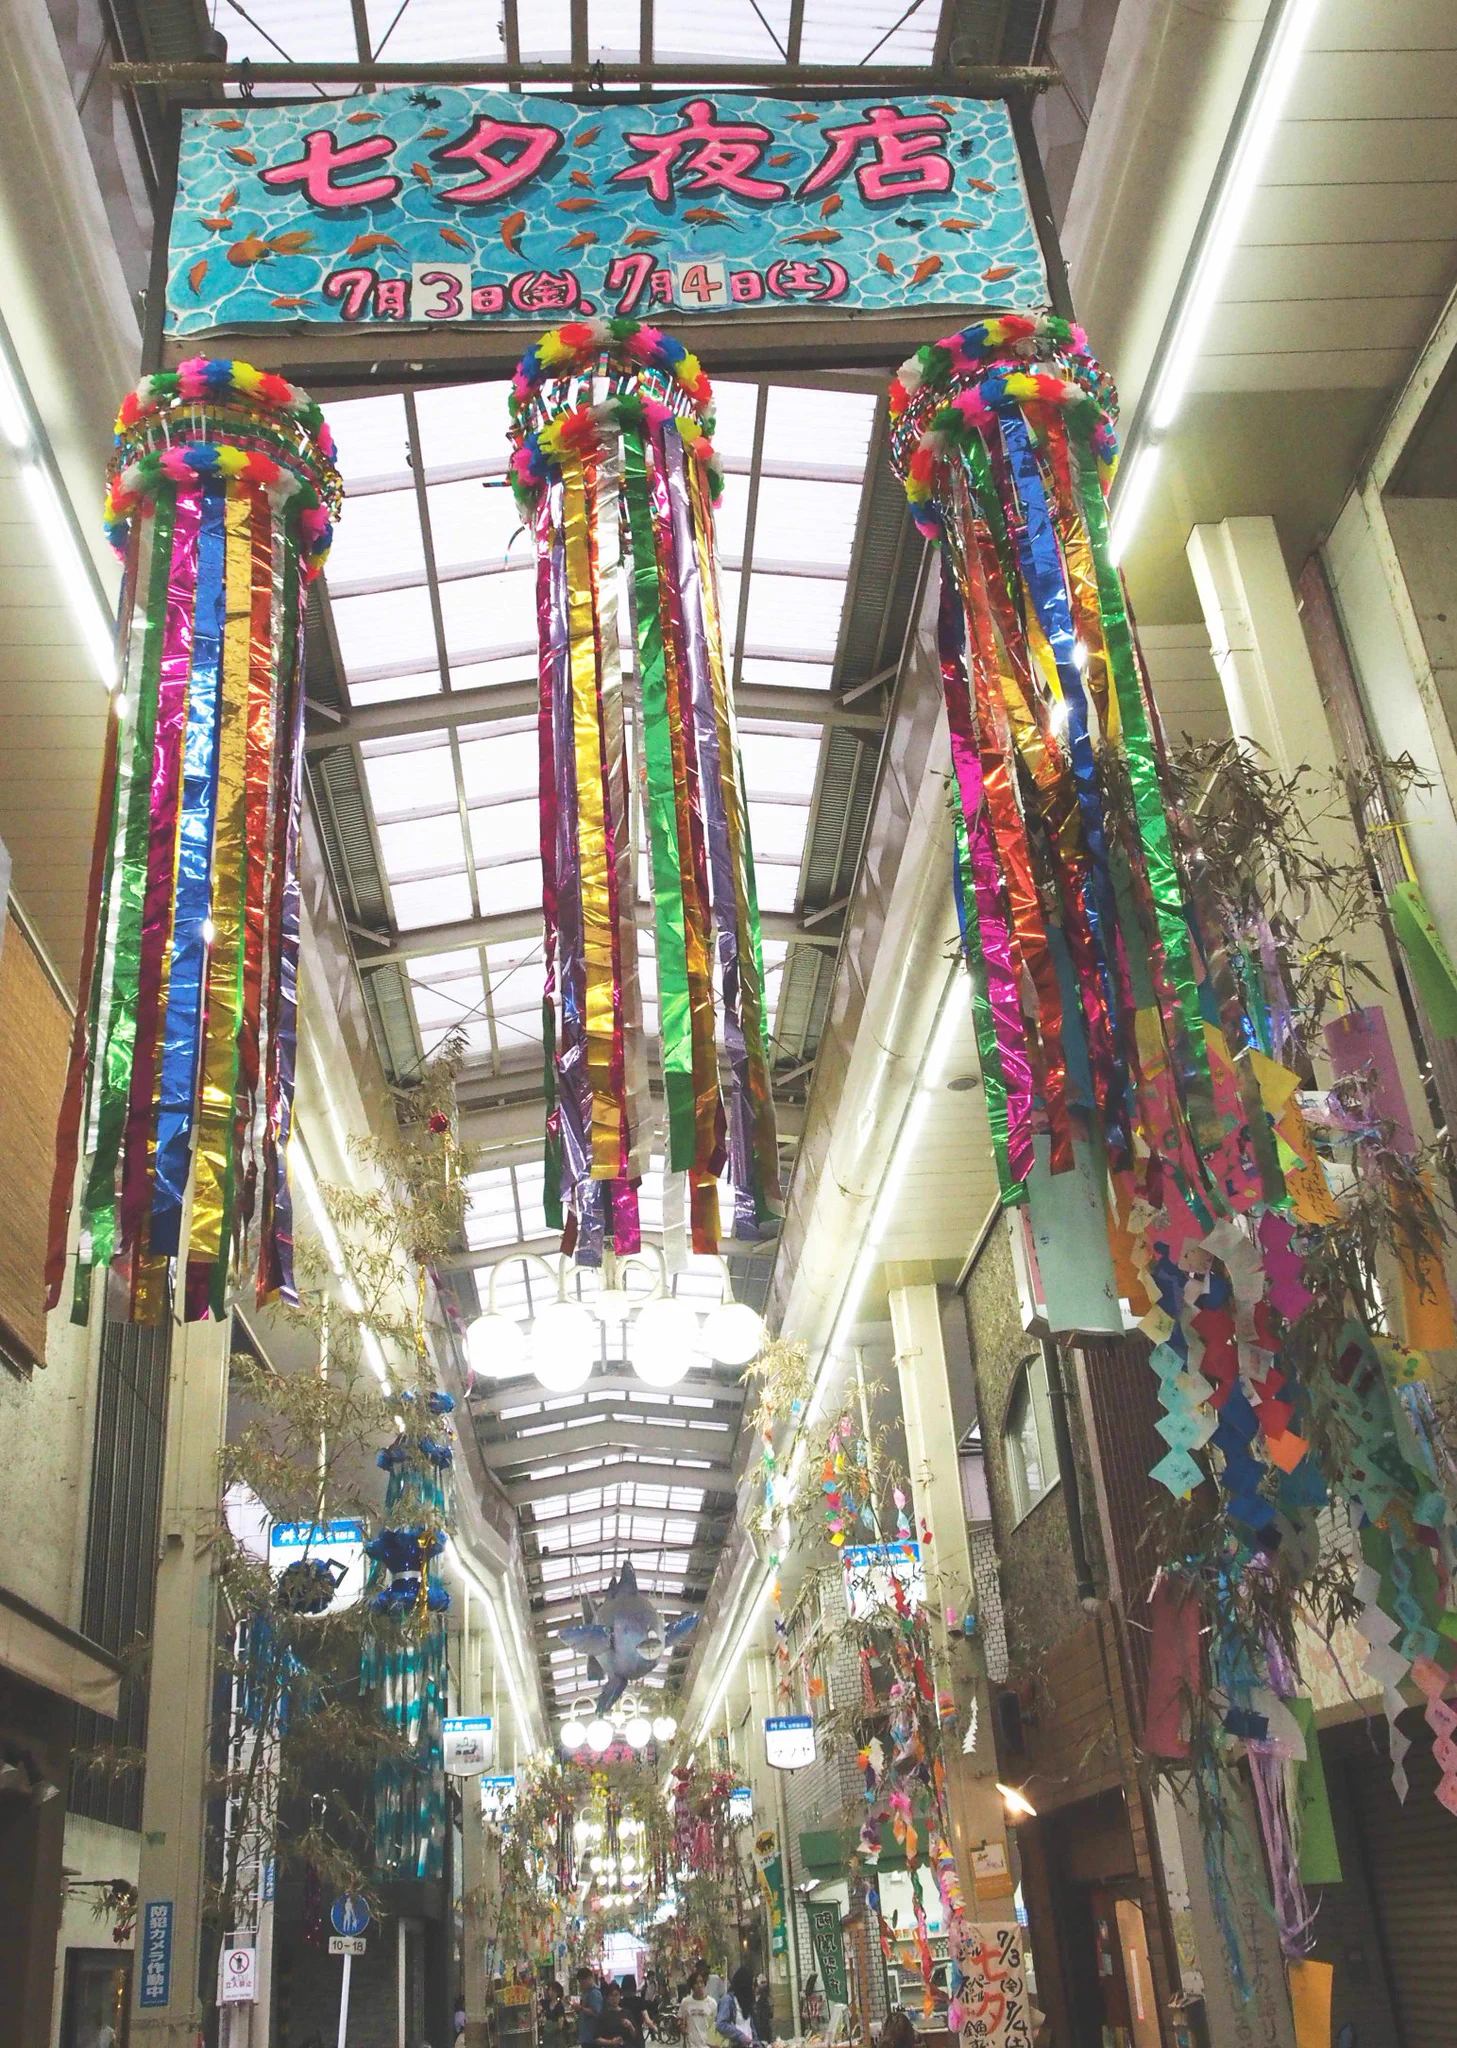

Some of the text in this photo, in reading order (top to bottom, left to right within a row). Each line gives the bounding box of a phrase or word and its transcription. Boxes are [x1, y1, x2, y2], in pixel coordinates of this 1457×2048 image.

[258, 98, 956, 208] 七夕夜店
[146, 1905, 168, 1997] 防犯カメラ作動中
[996, 1930, 1021, 1968] 7/3
[1000, 1977, 1024, 1998] (金)
[1004, 2000, 1029, 2036] 7/4
